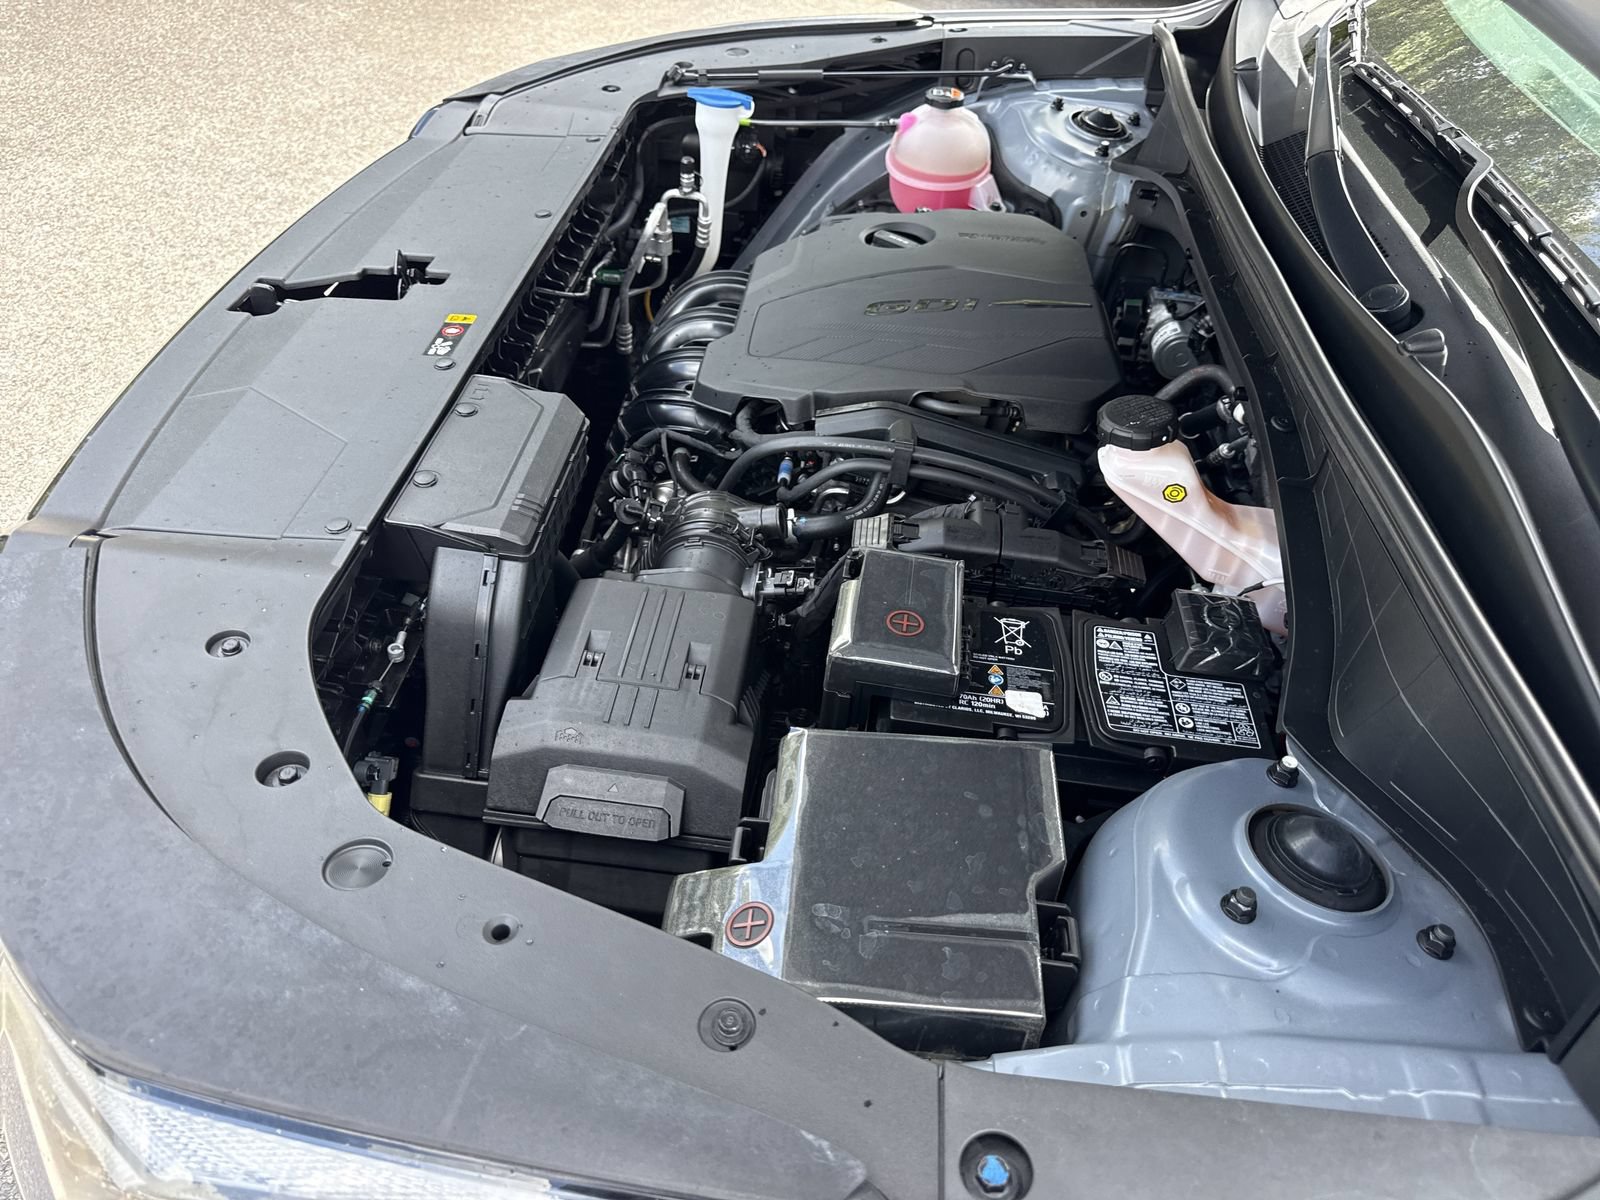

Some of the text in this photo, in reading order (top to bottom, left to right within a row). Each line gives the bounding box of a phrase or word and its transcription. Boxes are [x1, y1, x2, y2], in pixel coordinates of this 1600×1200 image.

[1005, 645, 1023, 655] Pb
[971, 700, 996, 709] 120min
[979, 696, 1005, 705] (20HR)
[559, 807, 656, 829] PULL OUT TO OPEN
